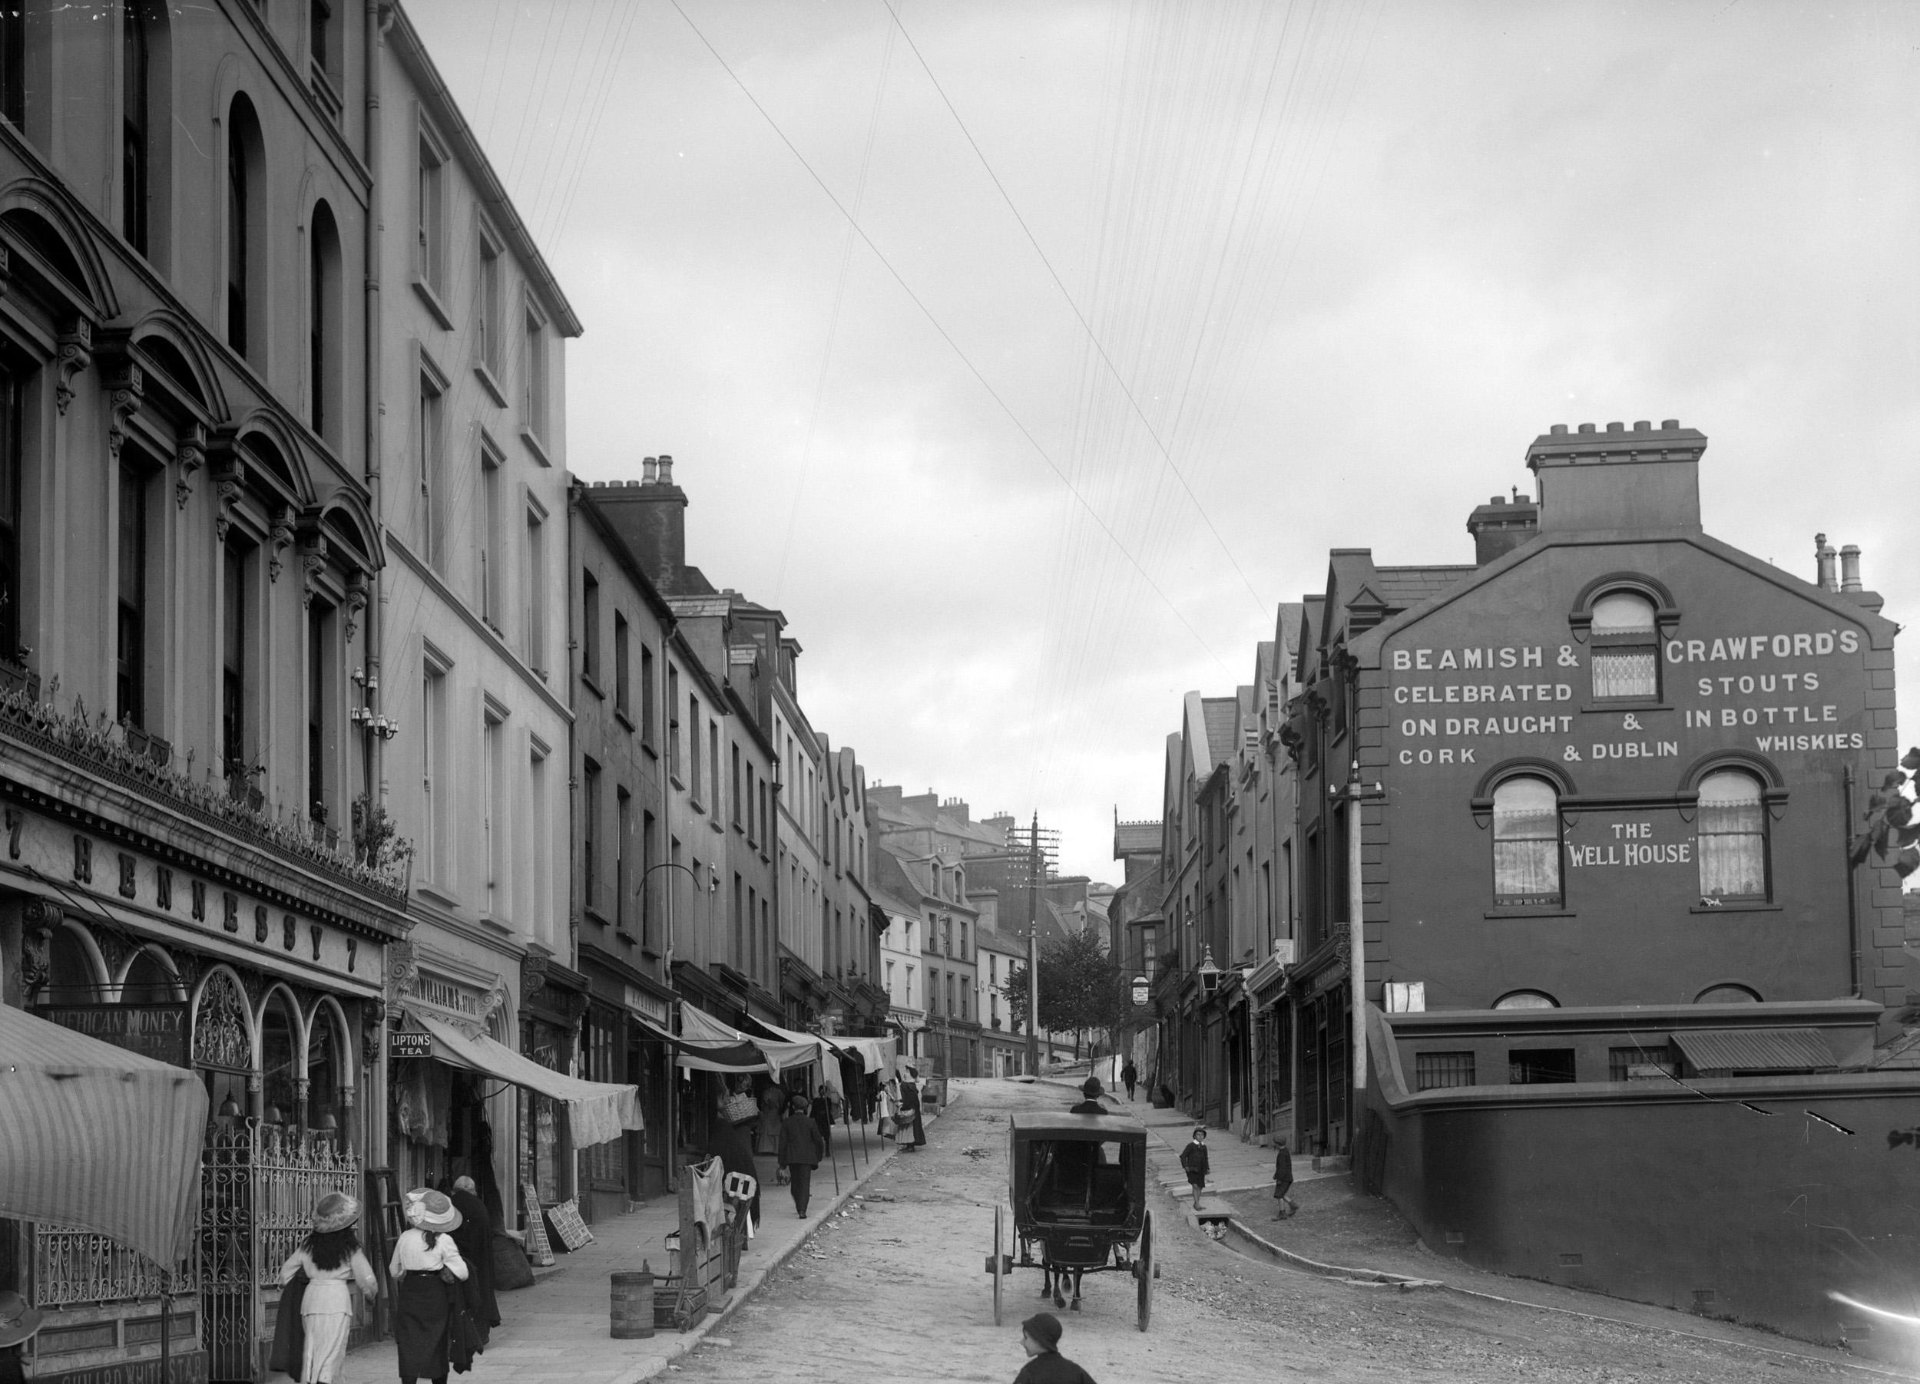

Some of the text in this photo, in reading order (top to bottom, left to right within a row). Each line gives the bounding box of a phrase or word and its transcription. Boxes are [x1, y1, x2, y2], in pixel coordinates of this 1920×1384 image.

[1393, 629, 1859, 671] BEAMISH & CRAWFORD'S
[1394, 672, 1820, 704] CELEBRATED STOUTS
[1401, 704, 1838, 737] ON DRAUGHT & IN BOTTLE
[1399, 732, 1864, 765] CORK & DUBLIN WHISKIES
[1610, 822, 1653, 839] THE
[72, 834, 324, 962] HENNESSY
[125, 1009, 184, 1037] MONEY
[391, 1032, 431, 1047] LIPTON'S
[399, 1046, 423, 1056] TEA
[168, 1355, 203, 1384] STAR
